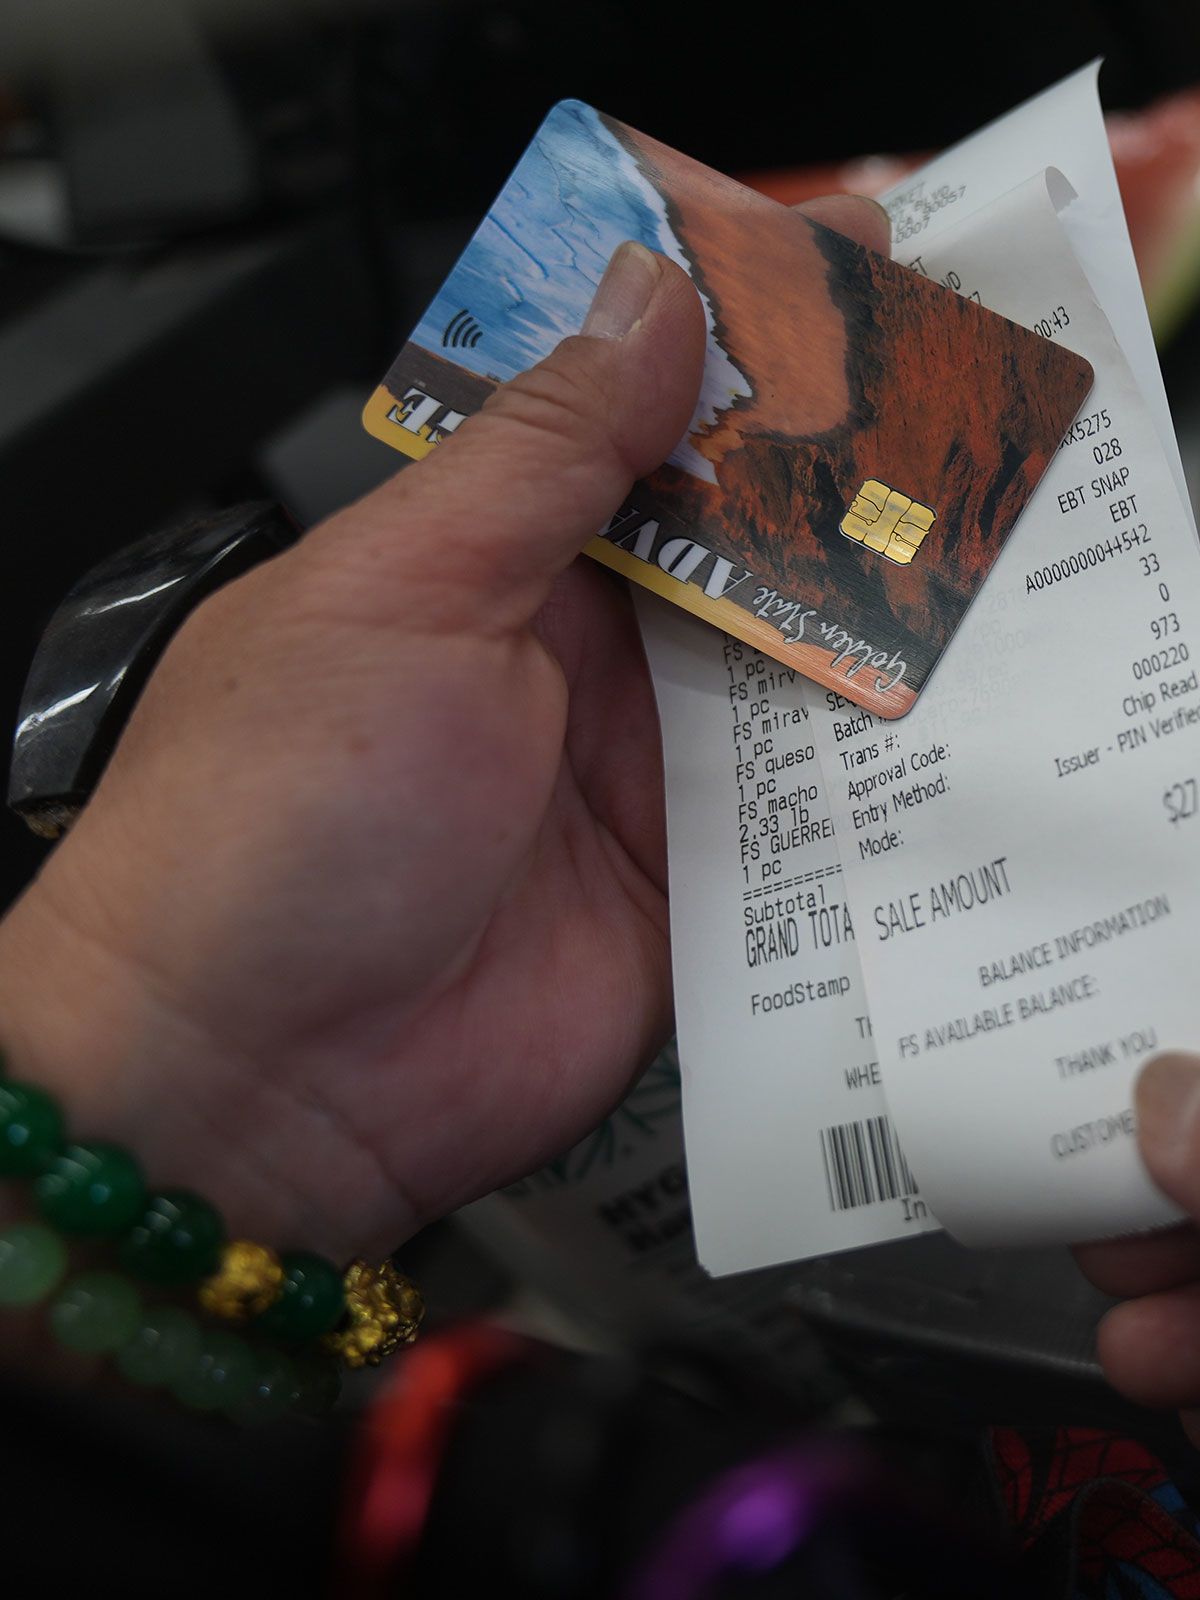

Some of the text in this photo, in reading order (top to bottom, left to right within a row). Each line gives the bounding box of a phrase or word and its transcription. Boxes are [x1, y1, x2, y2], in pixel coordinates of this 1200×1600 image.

[1093, 437, 1123, 465] 028
[1057, 466, 1131, 514] EBT SNAP
[1108, 495, 1140, 523] EBT
[1025, 523, 1152, 595] A0000000044542
[1139, 552, 1161, 577] 33
[1159, 582, 1170, 602] 0
[752, 587, 907, 693] Golden State
[1150, 613, 1181, 640] 973
[723, 642, 744, 665] FS
[1132, 642, 1190, 681] 000220
[745, 659, 766, 681] pc
[729, 681, 749, 705] FS
[1122, 671, 1200, 718] Chip Read
[750, 699, 770, 721] pc
[733, 721, 753, 744] FS
[833, 712, 874, 742] Batch
[736, 744, 816, 784] FS queso
[754, 738, 774, 760] pc
[840, 744, 879, 772] Trans
[1054, 744, 1101, 778] Issuer
[1116, 724, 1148, 753] PIN
[848, 744, 952, 801] Approval Code:
[738, 782, 819, 824] FS macho
[757, 777, 778, 799] pc
[852, 773, 951, 830] Entry Method:
[738, 815, 780, 844] 2.33
[741, 841, 761, 865] FS
[859, 831, 904, 860] Mode:
[761, 858, 783, 879] pc
[744, 884, 826, 927] Subtotal
[873, 856, 1013, 942] SALE AMOUNT
[745, 917, 800, 968] GRAND
[979, 893, 1172, 988] BALANCE INFORMATION
[751, 975, 851, 1016] FoodStamp
[898, 973, 1100, 1059] FS AVAILABLE BALANCE:
[1053, 1042, 1117, 1080] THANK
